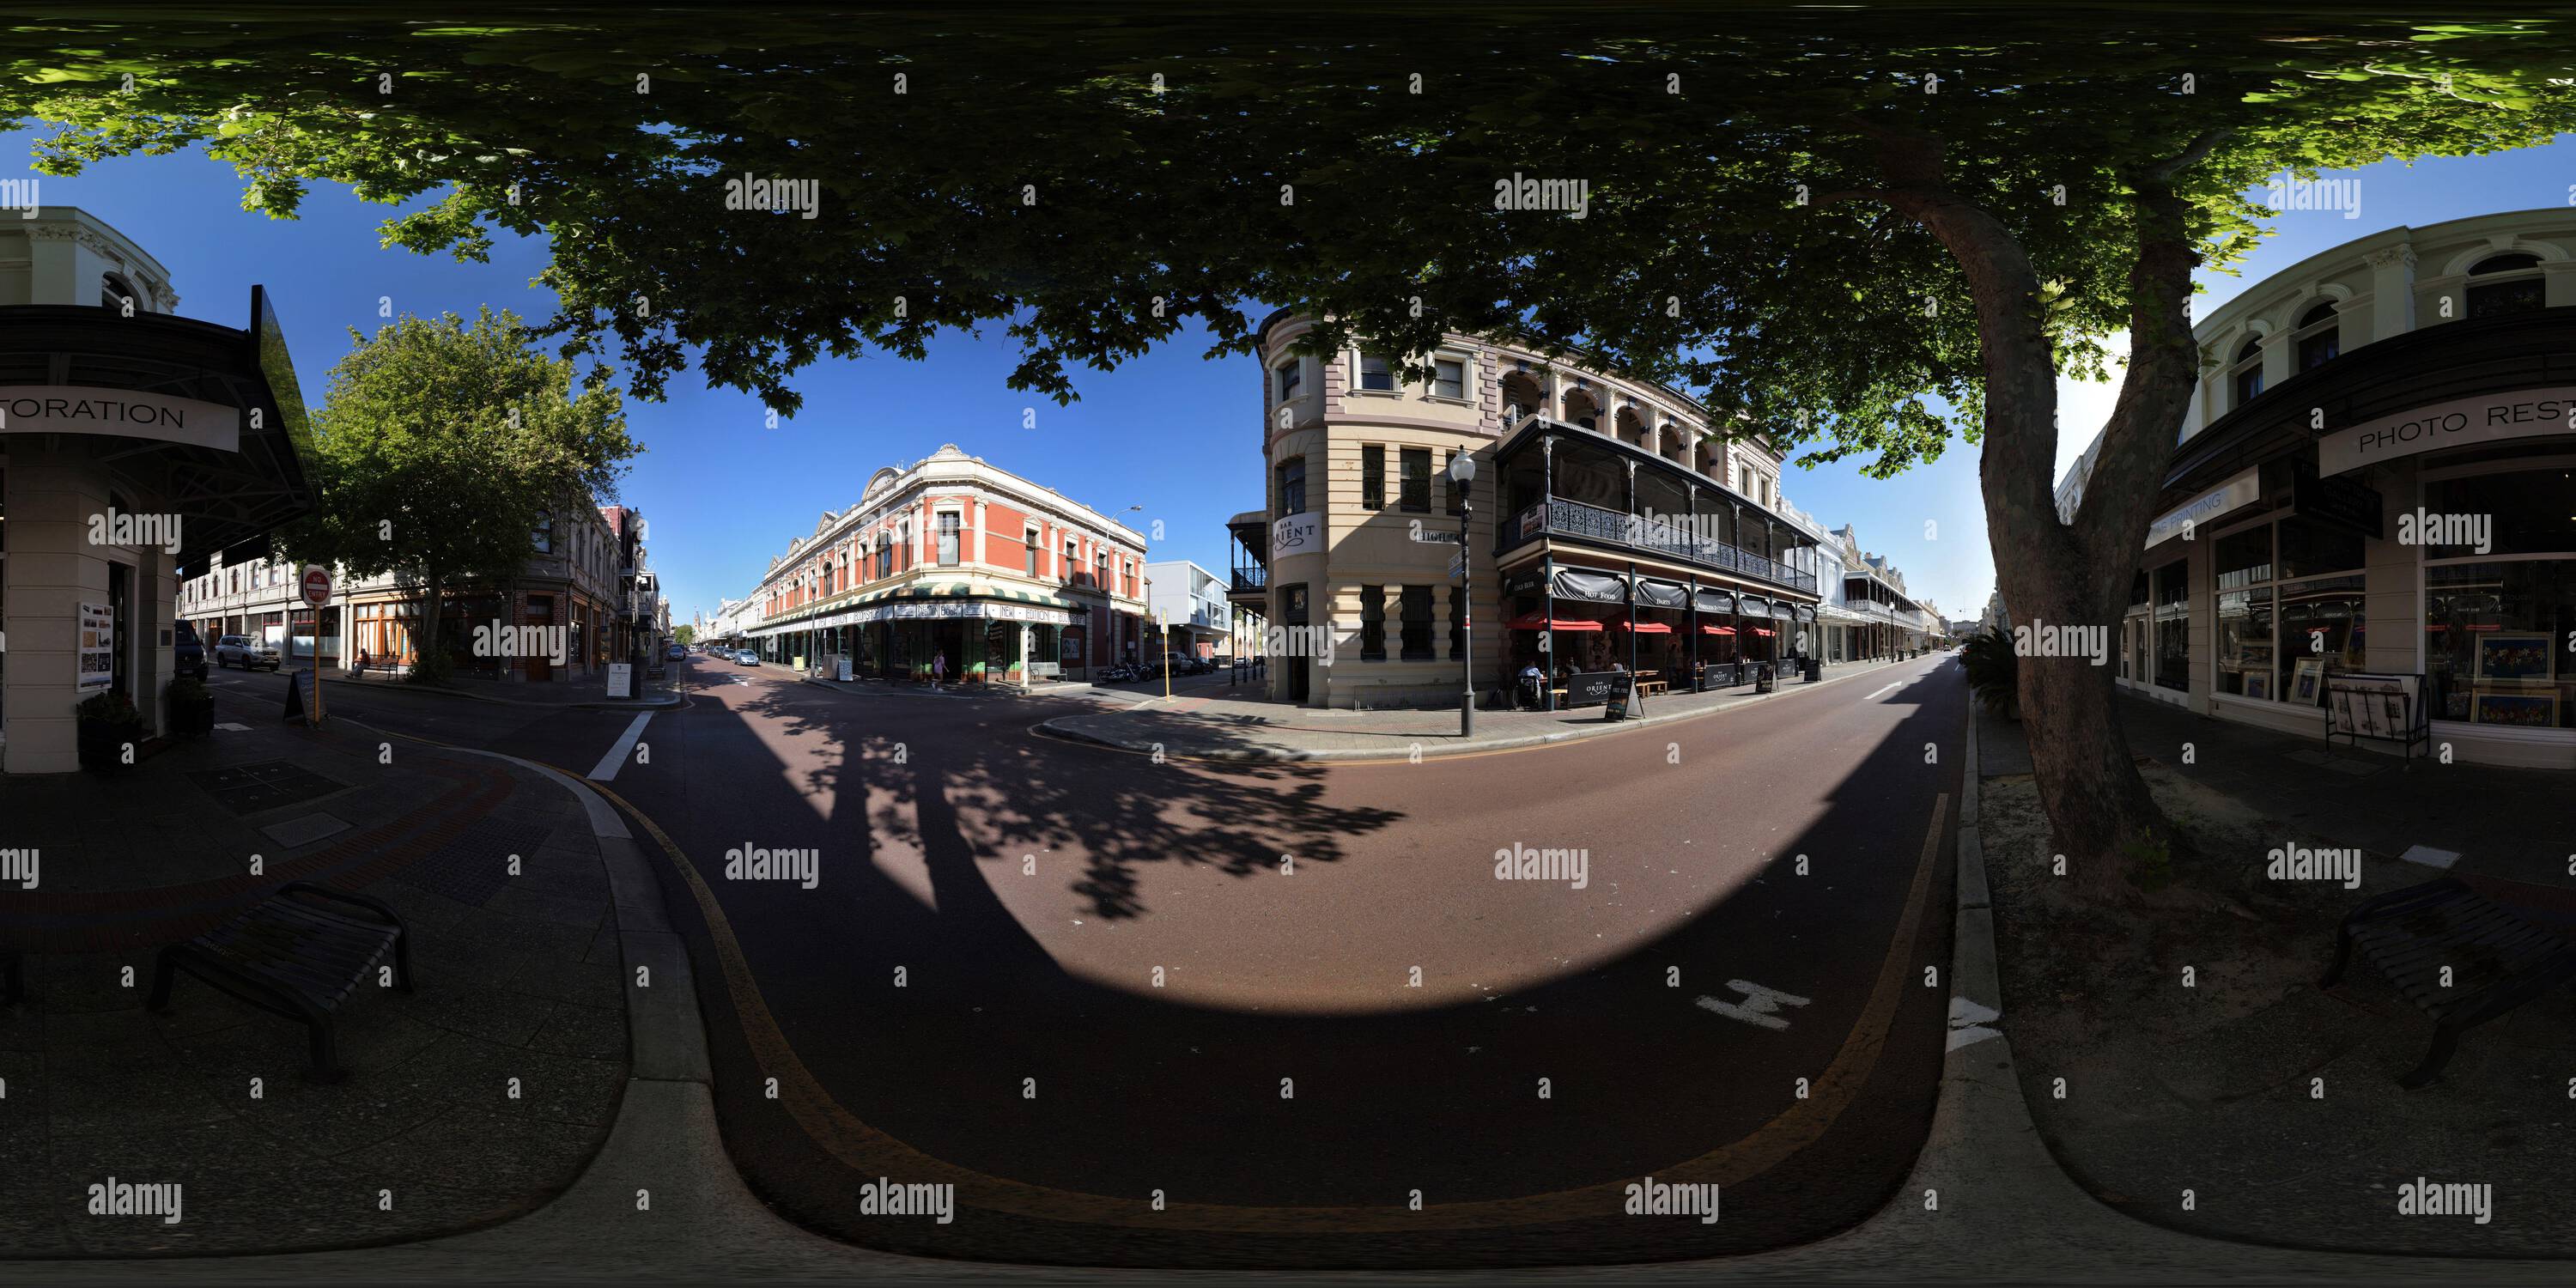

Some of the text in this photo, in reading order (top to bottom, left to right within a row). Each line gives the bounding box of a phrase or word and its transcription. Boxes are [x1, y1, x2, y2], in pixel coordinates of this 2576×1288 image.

[2359, 412, 2468, 453] PHOTO
[2170, 493, 2221, 529] PRINTING
[1601, 592, 1616, 600] FOOD
[1001, 605, 1013, 618] NEW
[1027, 608, 1049, 621] EDITION
[1586, 683, 1612, 692] ORIENT
